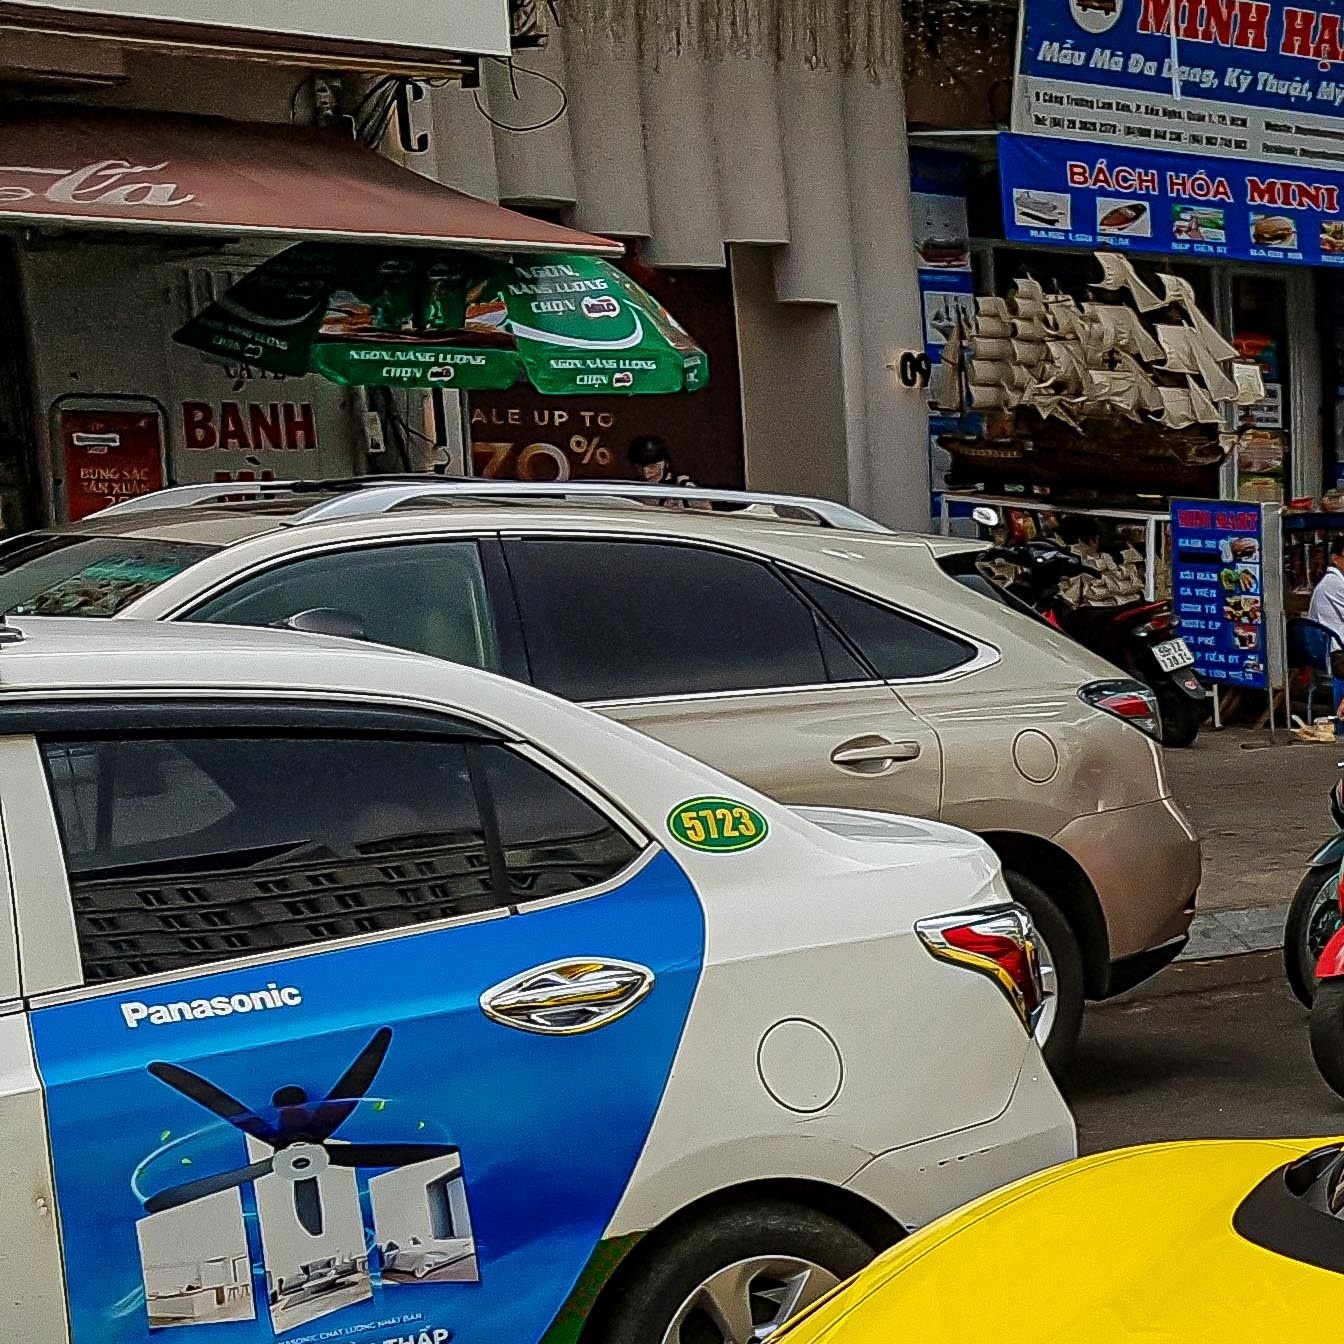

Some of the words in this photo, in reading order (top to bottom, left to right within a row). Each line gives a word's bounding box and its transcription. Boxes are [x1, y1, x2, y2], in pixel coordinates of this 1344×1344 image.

[1137, 0, 1271, 51] MINH
[1037, 40, 1086, 65] Mẫu
[1089, 48, 1124, 71] Mã
[1127, 53, 1158, 76] Đa
[1224, 67, 1254, 93] Kỹ
[1257, 71, 1313, 102] Thuật,
[1067, 158, 1159, 195] BÁCH
[1167, 169, 1233, 202] HÓA
[1246, 176, 1339, 213] MINI
[534, 410, 569, 426] UP
[580, 411, 613, 427] TO
[680, 807, 756, 842] 5723
[120, 983, 302, 1028] Panasonic
